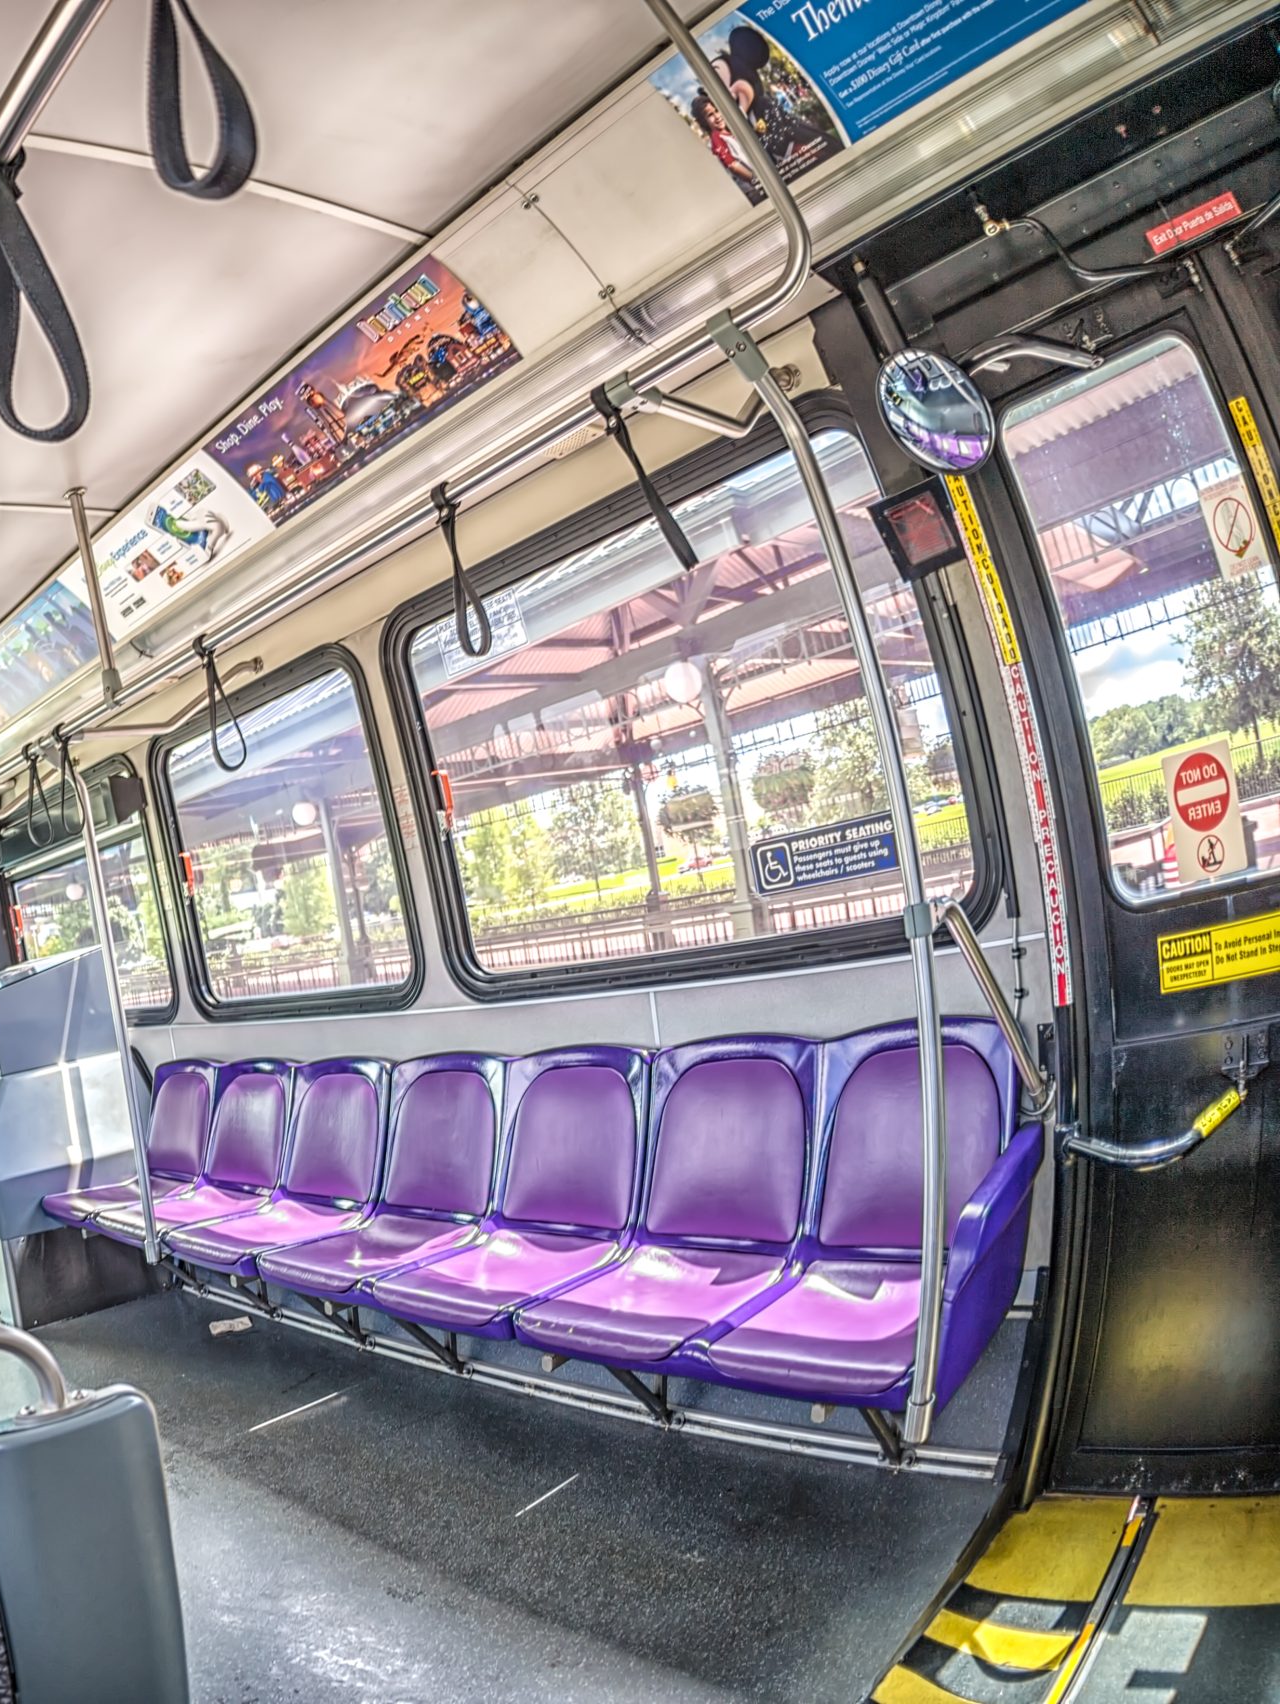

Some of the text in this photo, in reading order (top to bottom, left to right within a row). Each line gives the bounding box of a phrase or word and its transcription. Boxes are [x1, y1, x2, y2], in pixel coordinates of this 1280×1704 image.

[1152, 232, 1167, 245] Exit
[1181, 215, 1204, 230] Puerta
[1203, 211, 1213, 220] de
[1212, 201, 1233, 216] Salida
[356, 273, 441, 343] Downtown
[387, 297, 442, 343] DISNEY
[214, 396, 284, 454] Shop. Dine. Play.
[1234, 401, 1275, 500] CAUTION
[107, 526, 151, 564] Experience
[981, 557, 1017, 660] CUIDADO
[791, 820, 892, 851] PRIORITY SEATING
[1009, 664, 1066, 976] CAUTION PRECAUCIÓN
[793, 839, 880, 863] Passengers must give up
[794, 863, 813, 872] these
[815, 859, 833, 868] seats
[843, 851, 866, 863] guests
[867, 847, 888, 857] using
[796, 867, 838, 880] wheelchairs
[845, 860, 875, 871] scooters
[1162, 935, 1210, 958] CAUTION
[1214, 941, 1222, 951] To
[1223, 937, 1241, 949] Avoid
[1243, 930, 1272, 944] Personal
[1215, 955, 1224, 964] Do
[1225, 952, 1237, 961] Not
[1238, 947, 1258, 959] Stand
[1259, 946, 1266, 954] In
[1165, 959, 1209, 973] DOORS MAY OPEN
[1169, 969, 1206, 982] UNEXPECTEDLY
